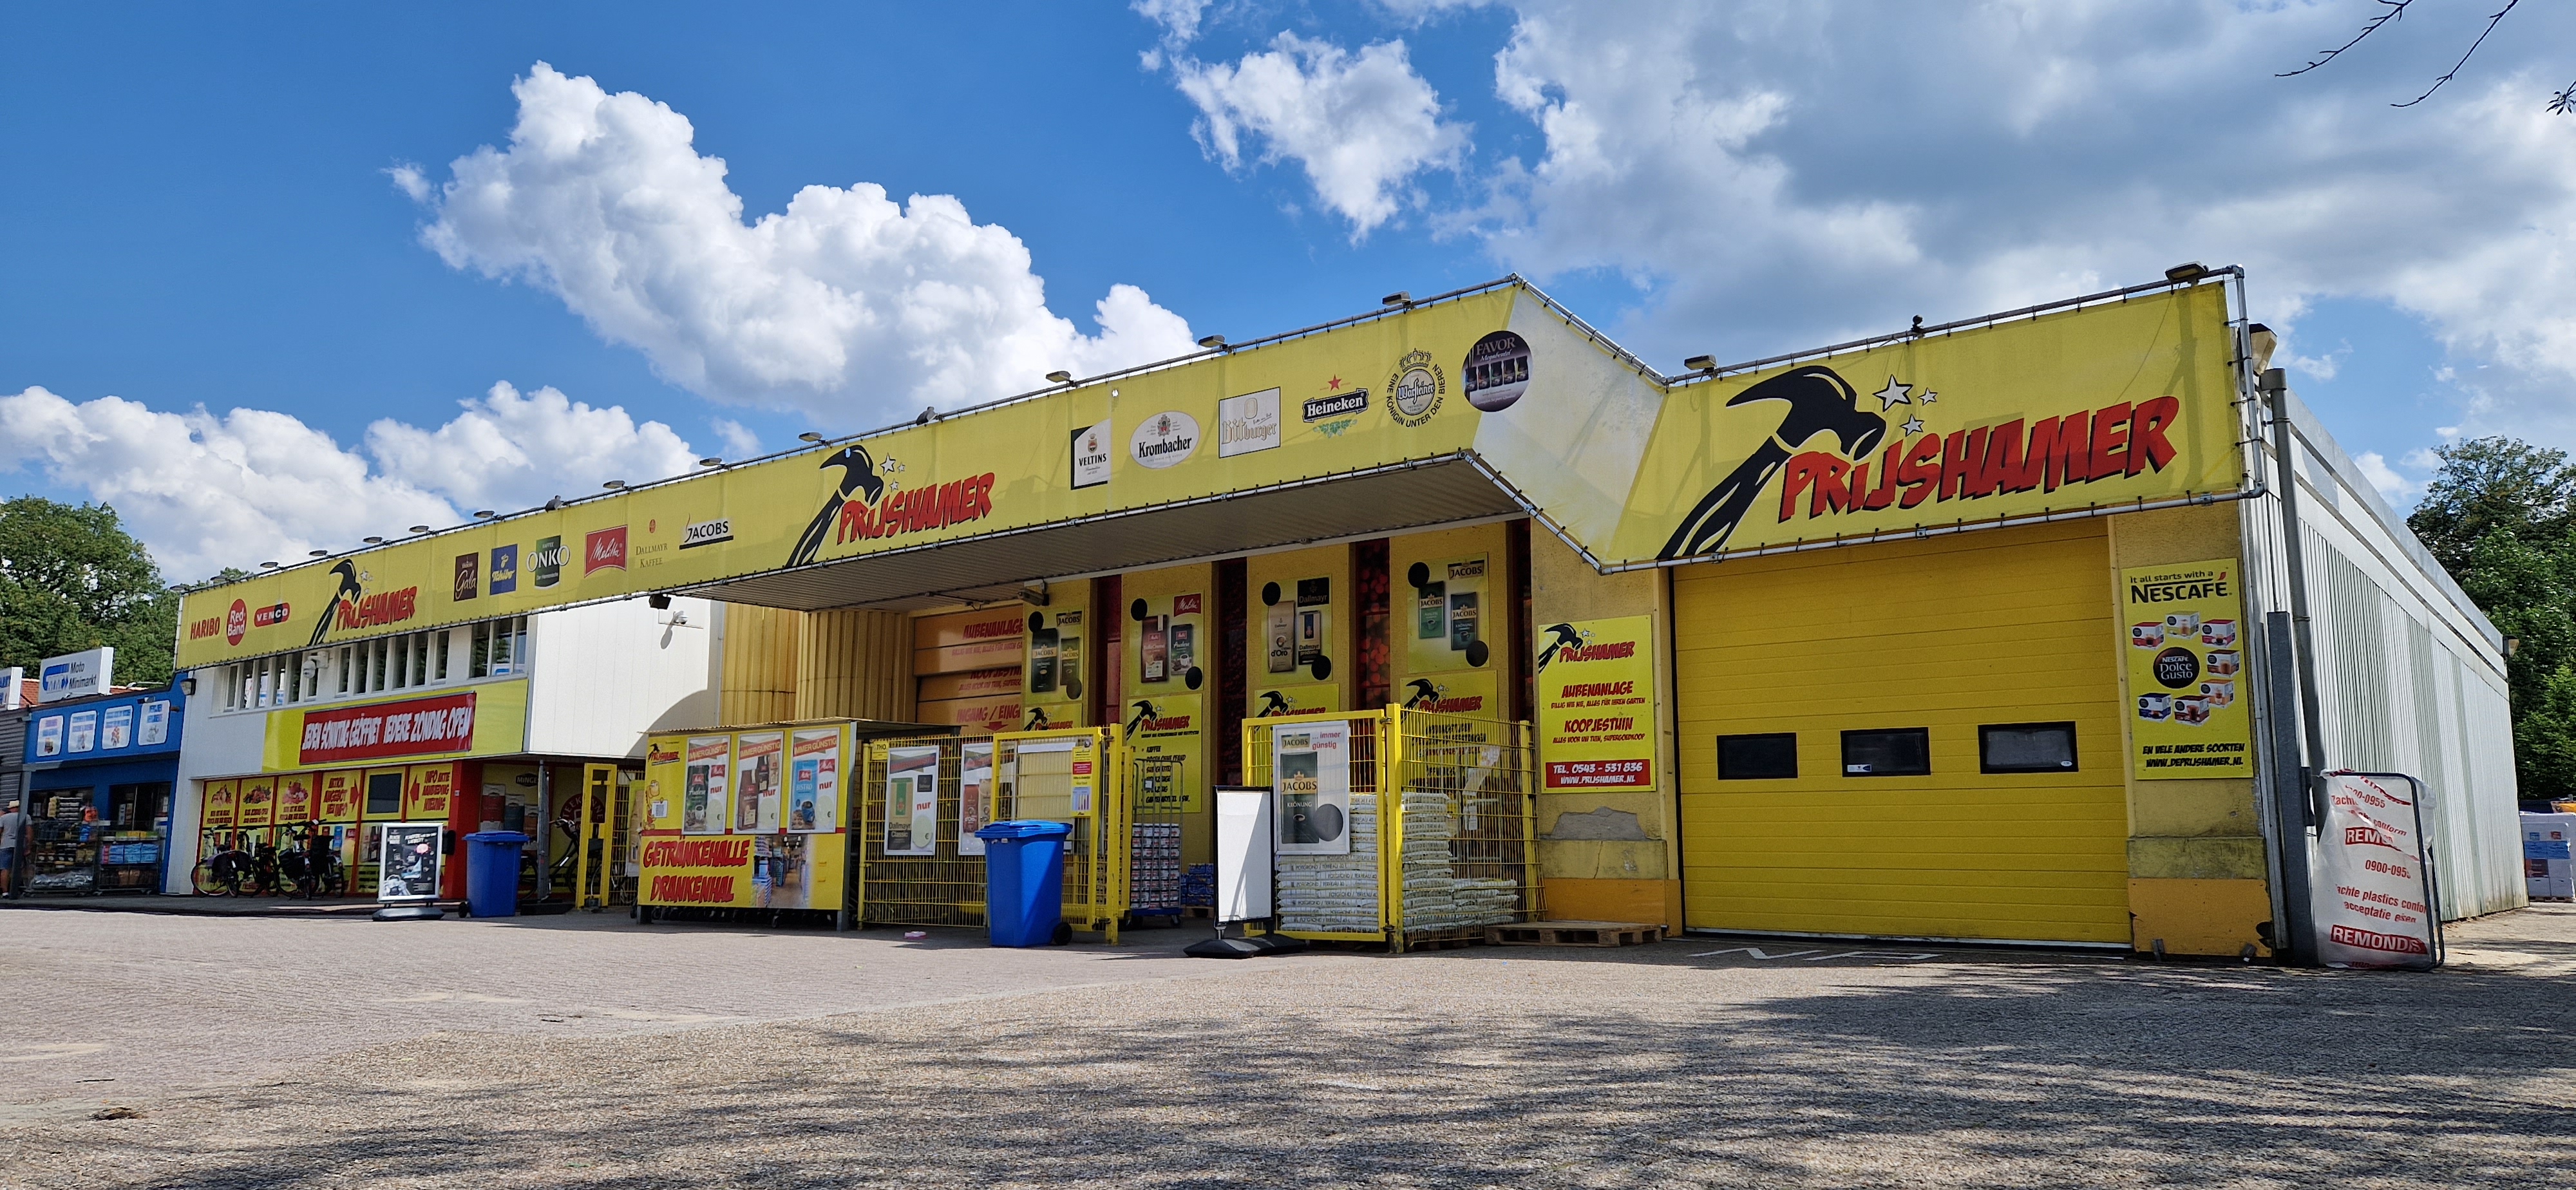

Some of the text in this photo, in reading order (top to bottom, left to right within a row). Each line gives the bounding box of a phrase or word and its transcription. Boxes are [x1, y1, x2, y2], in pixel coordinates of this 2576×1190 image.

[1477, 337, 1517, 355] FAVOR
[1481, 349, 1512, 361] Megabeutel
[1386, 364, 1445, 428] EINE KÖNIGIN UNTER DEN BIEREN
[1307, 397, 1363, 417] Heineken
[1222, 417, 1277, 444] Bitburger
[1139, 435, 1191, 458] Krombacher
[1079, 453, 1106, 466] VELTINS
[1779, 395, 2179, 524] PRIJSHAMER
[837, 472, 995, 545] PRIJSHAMER
[685, 521, 728, 542] JACOBS
[589, 537, 620, 563] Melitta
[636, 543, 667, 555] DALLMAYR
[526, 545, 570, 572] ONKO
[640, 558, 663, 568] KAFFEE
[492, 569, 515, 582] Tchibo
[1450, 567, 1482, 578] JACOBS
[2184, 570, 2206, 579] with
[455, 570, 476, 600] Gala
[1176, 598, 1197, 612] Melitta
[1299, 595, 1327, 603] Dallmayr
[1421, 599, 1443, 607] JACOBS
[230, 607, 244, 624] Red
[257, 609, 288, 621] VENCO
[336, 586, 417, 632] PRIJSHAMER
[190, 616, 220, 639] HARIBO
[227, 620, 245, 636] Band
[1058, 616, 1080, 625] JACOBS
[1559, 641, 1635, 663] PRIJSHAMER
[70, 661, 84, 674] Moto
[2160, 663, 2192, 673] Dolce
[69, 674, 97, 690] Minimarkt
[2161, 671, 2193, 680] Gusto
[957, 707, 988, 723] INGANG
[410, 709, 448, 742] ZONDAG
[447, 706, 473, 740] OPEN
[1141, 715, 1190, 732] PRIJSHAMER
[1564, 717, 1634, 733] KOOPJESTUIN
[1284, 739, 1308, 747] JACOBS
[1604, 733, 1645, 742] SUPERGOEDKOOP
[740, 741, 781, 757] IMMER GÜNSTIG
[794, 738, 837, 754] IMMER GÜNSTIG
[1312, 741, 1337, 750] günstig
[2143, 742, 2245, 755] EN VELE ANDERE SOORTEN
[1553, 764, 1569, 774] TEL.
[1571, 764, 1596, 773] 0543
[1605, 763, 1622, 772] 531
[1623, 762, 1643, 771] 836
[2146, 757, 2243, 768] WWW.DEPRIJSHAMER.NL
[516, 776, 538, 784] MINGE
[819, 781, 832, 789] nur
[1282, 781, 1317, 792] JACOBS
[1560, 775, 1636, 784] WWW.PRIJSHAMER.NL
[710, 786, 723, 794] nur
[762, 789, 776, 797] nur
[562, 797, 604, 820] TEEKNNE
[916, 802, 931, 810] nur
[2374, 819, 2407, 836] conform
[2347, 829, 2380, 844] REM
[643, 835, 751, 868] GETRÄNKEHALLE
[650, 874, 735, 903] DRANKENHAL
[2336, 885, 2427, 914] achte plastics confor
[2344, 902, 2391, 920] acceptatie
